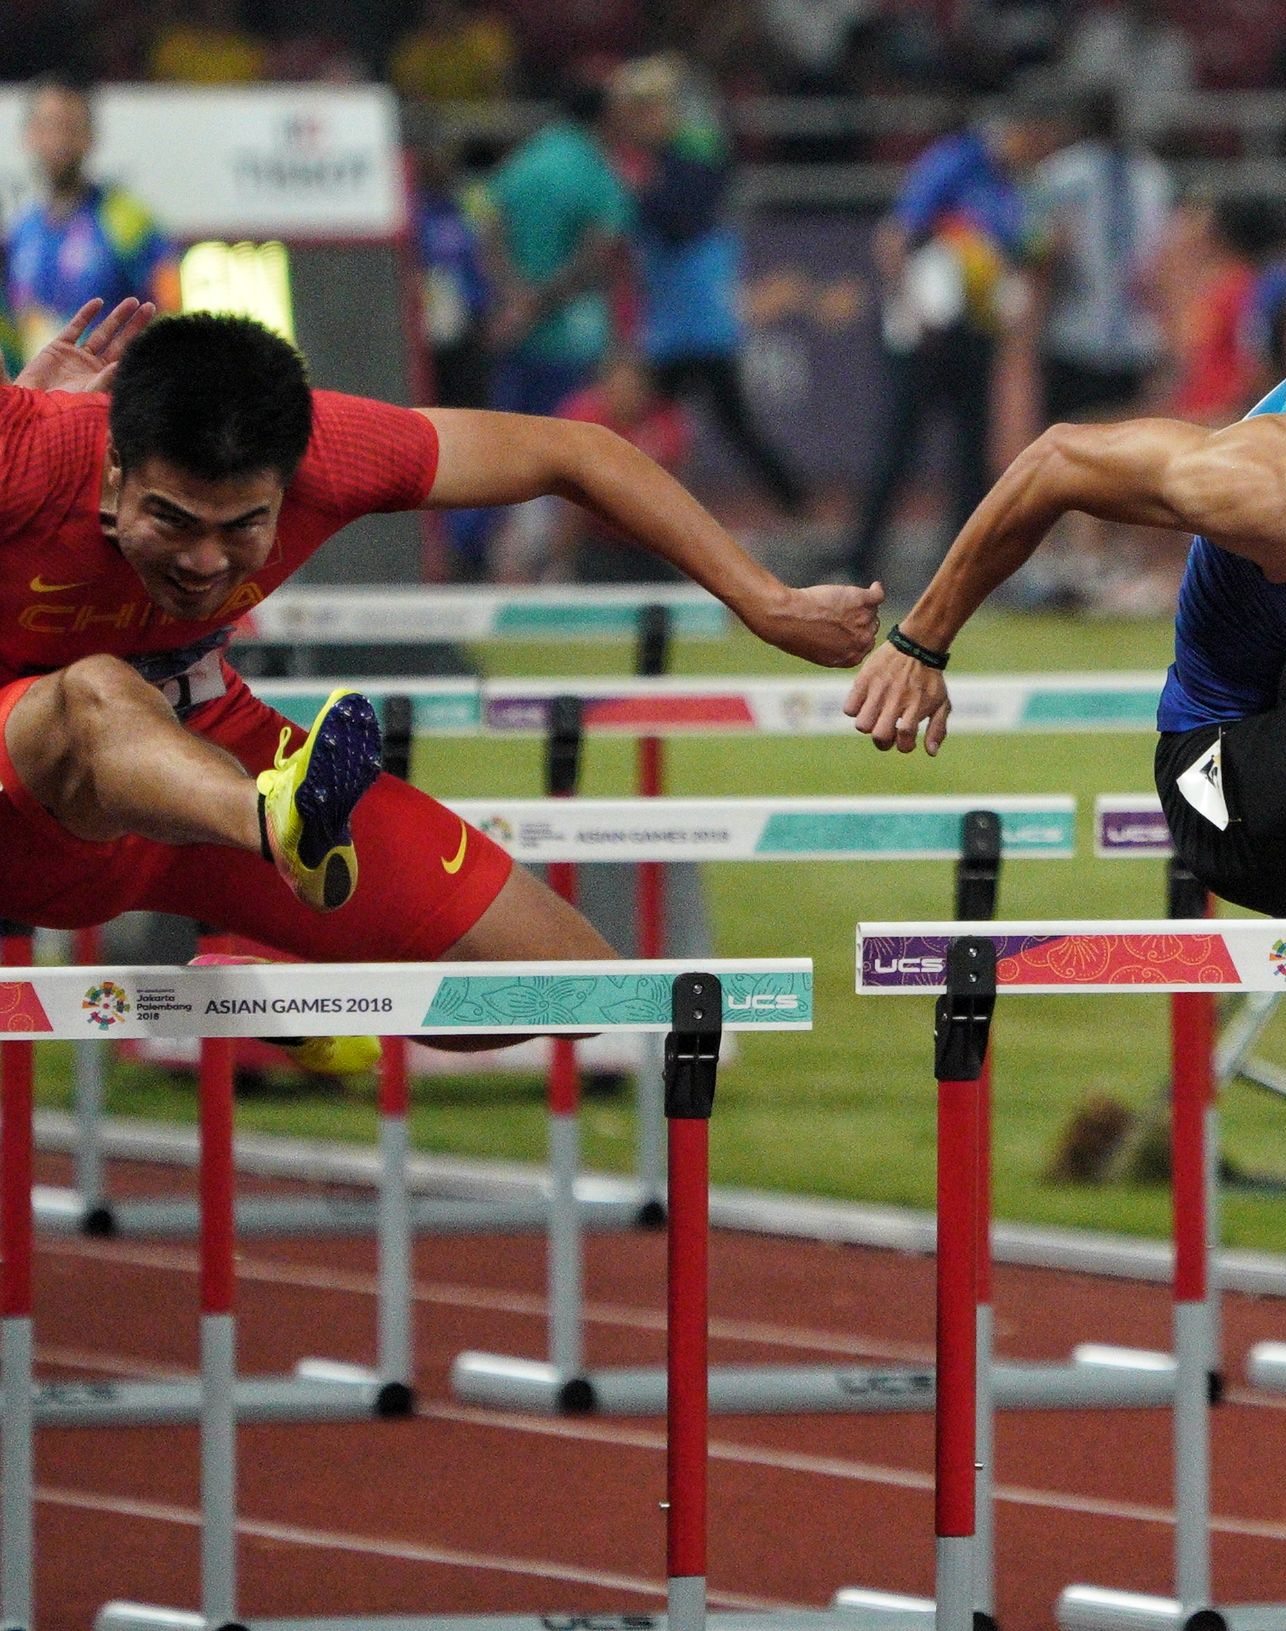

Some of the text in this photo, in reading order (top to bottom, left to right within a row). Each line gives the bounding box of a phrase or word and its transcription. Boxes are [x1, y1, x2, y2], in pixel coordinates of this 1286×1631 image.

[17, 581, 266, 634] CHIA
[873, 957, 944, 975] UCS
[136, 994, 176, 1003] Jakarta
[203, 996, 393, 1016] ASIAN GAMES 2018
[726, 993, 800, 1010] UCS
[136, 1003, 193, 1013] Palembang
[136, 1012, 160, 1021] 2018
